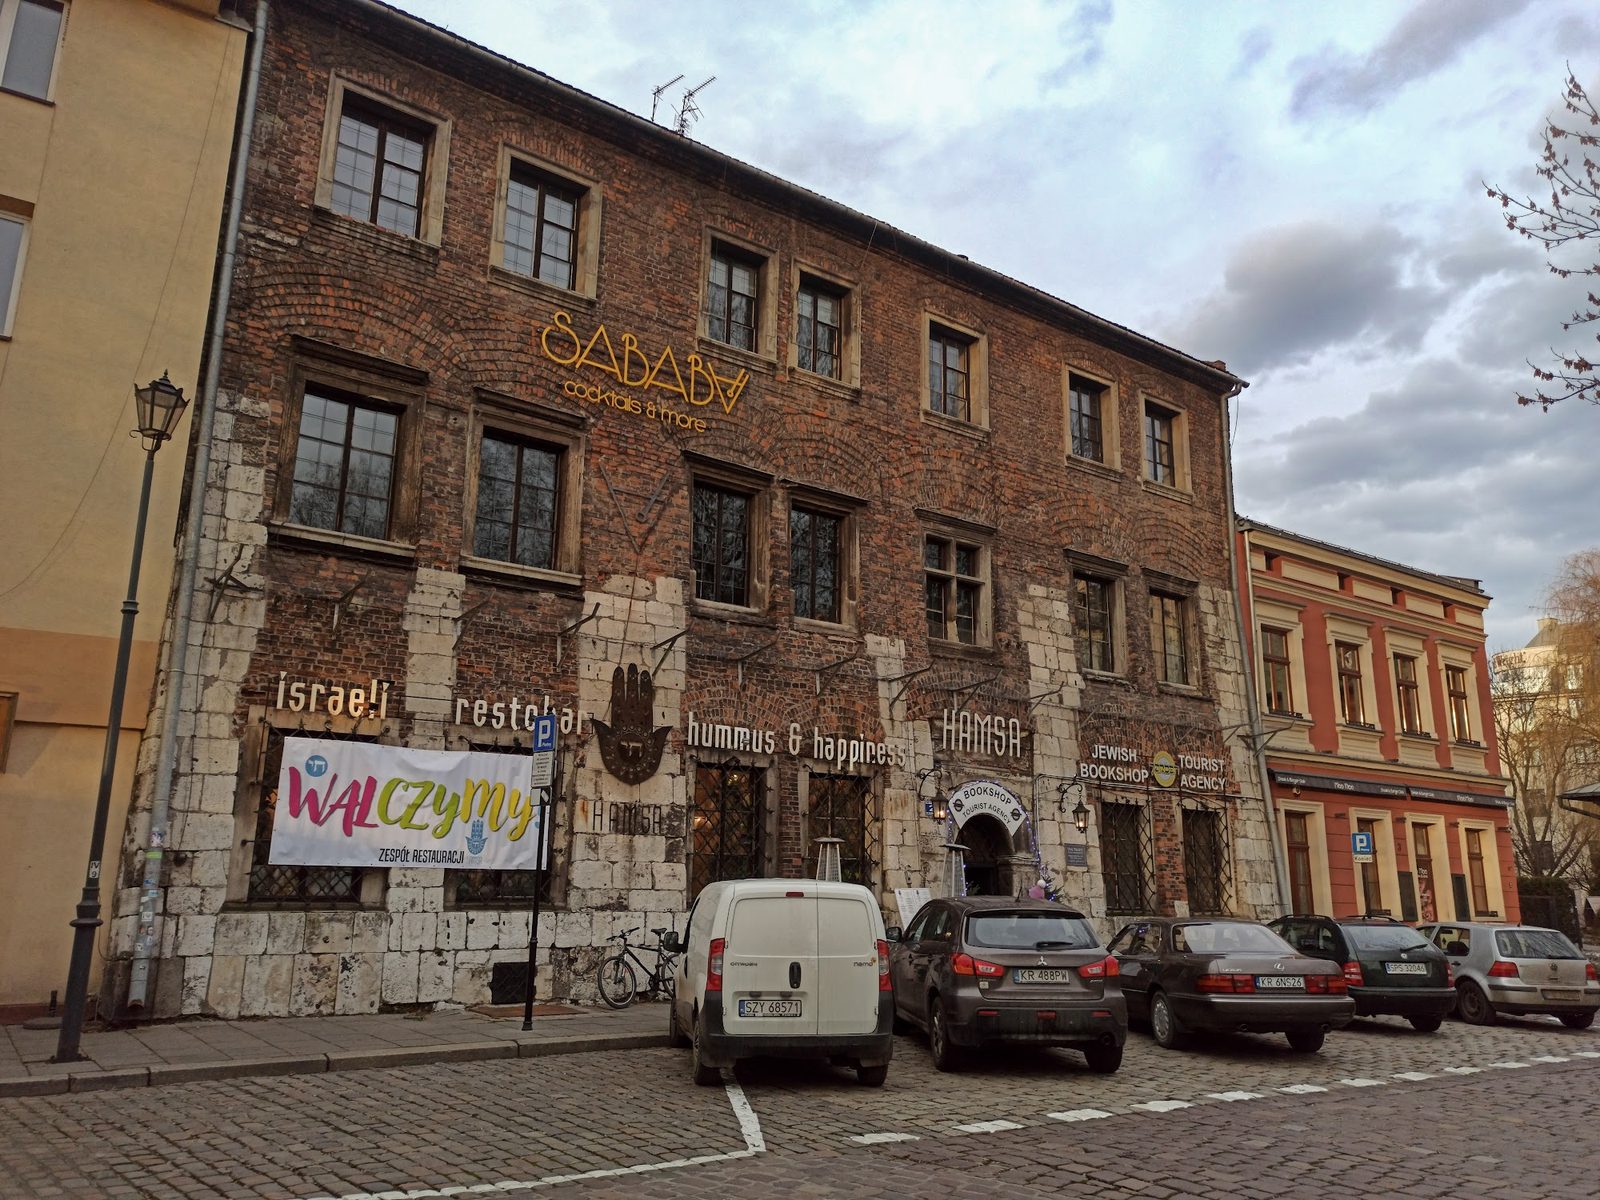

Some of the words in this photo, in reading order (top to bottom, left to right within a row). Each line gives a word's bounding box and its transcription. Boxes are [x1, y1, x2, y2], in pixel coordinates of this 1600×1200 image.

[541, 310, 749, 415] SABABA
[564, 380, 643, 415] cocktails
[646, 401, 656, 419] &
[661, 407, 707, 432] more
[276, 670, 390, 720] israeli
[538, 720, 551, 748] P
[687, 711, 775, 755] hummus
[788, 722, 803, 755] &
[813, 726, 906, 771] happiness
[942, 708, 1021, 758] HAMSA
[1091, 744, 1137, 763] JEWISH
[1080, 763, 1149, 783] BOOKSHOP
[1178, 754, 1225, 773] TOURIST
[1180, 774, 1226, 791] AGENCY
[963, 786, 1012, 805] BOOKSHOP
[592, 800, 662, 834] HAMSA
[962, 802, 988, 818] TOURIST
[988, 804, 1011, 824] AGENCY
[1355, 834, 1367, 851] P
[378, 846, 411, 862] ZESPÓŁ
[412, 849, 465, 864] RESTAURACJI
[1020, 970, 1035, 980] KR
[1038, 970, 1068, 981] 488PW
[1389, 963, 1404, 973] SPS
[1261, 979, 1273, 987] KR
[1276, 979, 1302, 987] 6NS26
[745, 1002, 765, 1013] SZY
[768, 1002, 799, 1013] 68571
